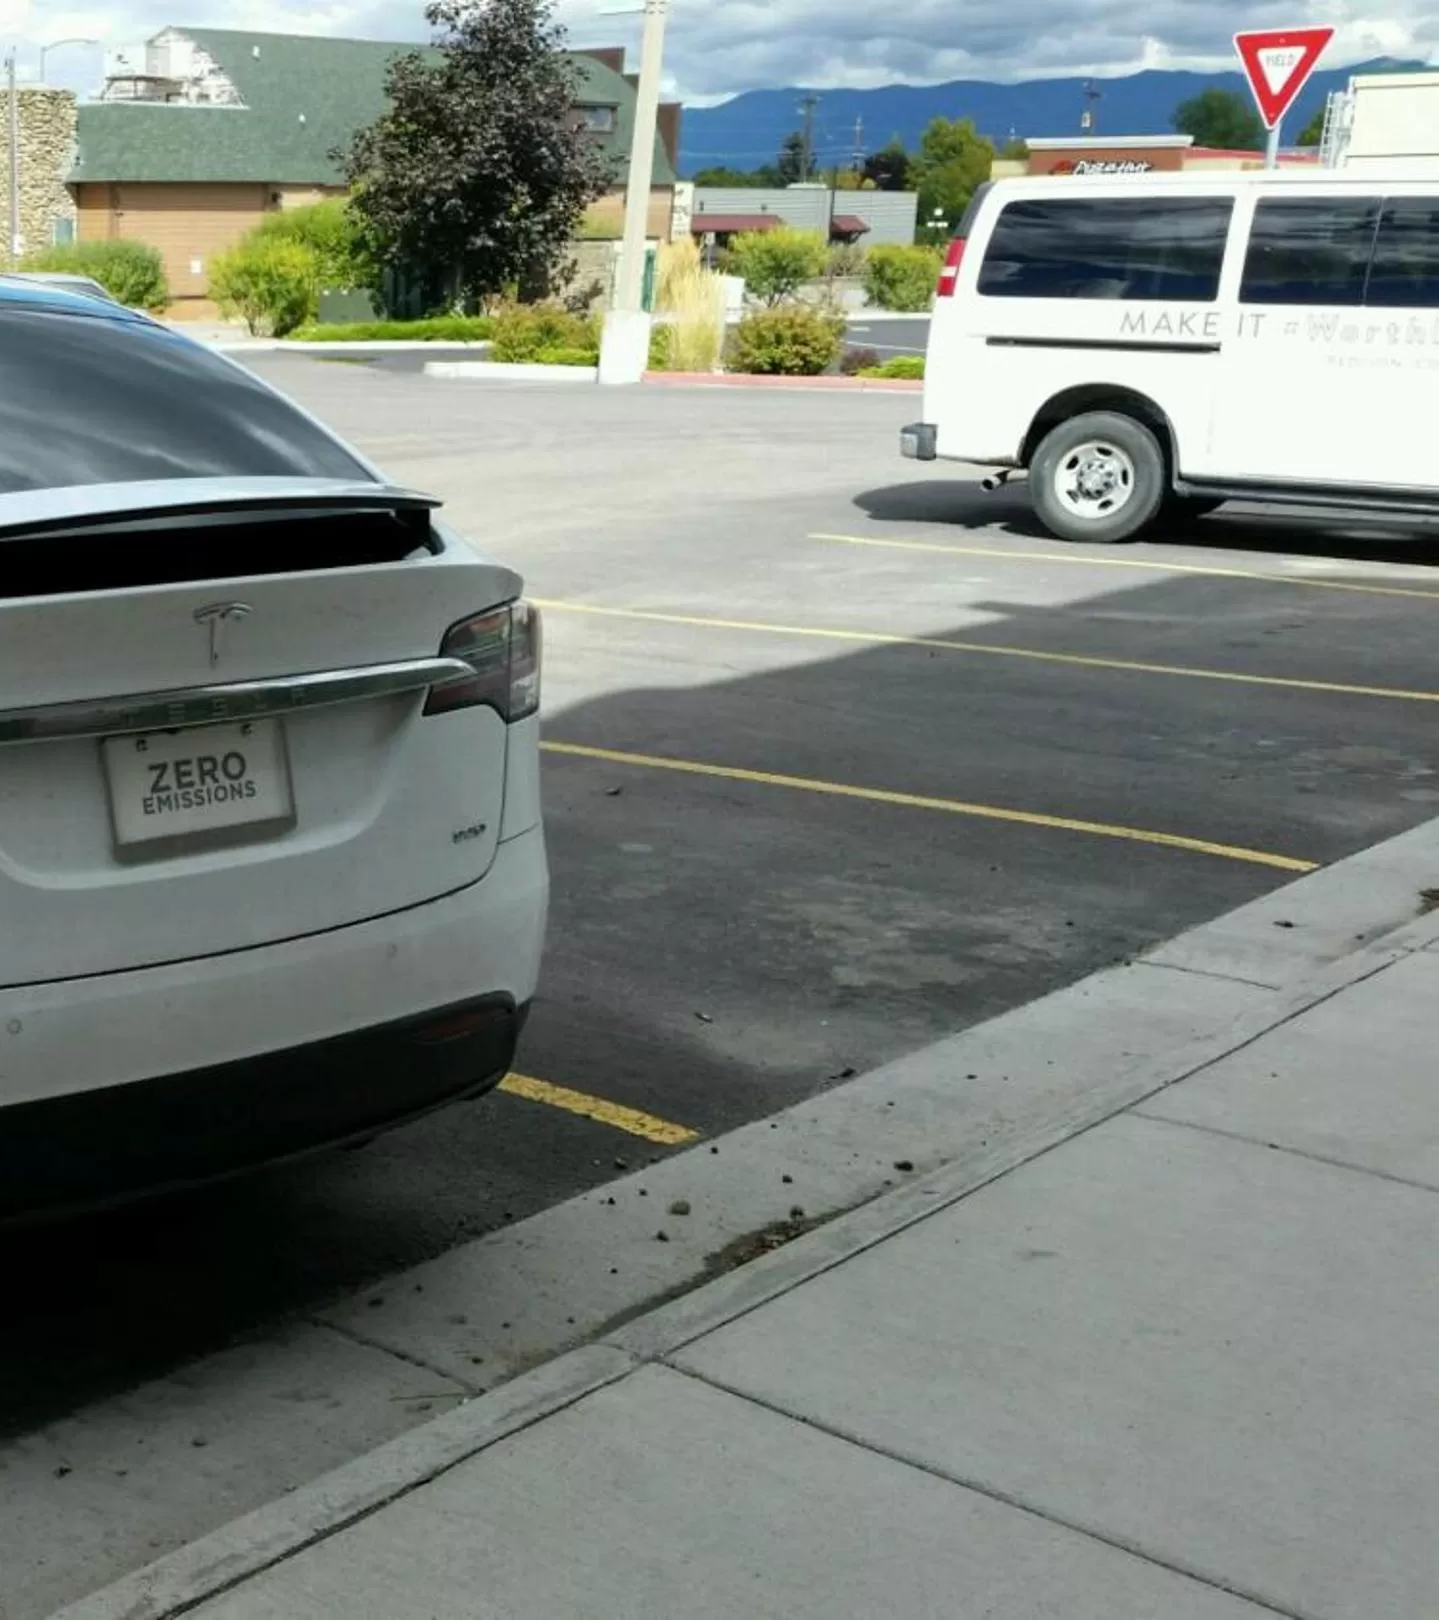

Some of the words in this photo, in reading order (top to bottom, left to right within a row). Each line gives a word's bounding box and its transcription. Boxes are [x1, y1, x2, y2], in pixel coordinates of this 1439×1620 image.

[1265, 53, 1295, 67] YIELD
[1119, 311, 1221, 337] MAKE
[1236, 312, 1267, 338] IT
[147, 751, 248, 795] ZERO
[142, 779, 258, 815] EMISSIONS
